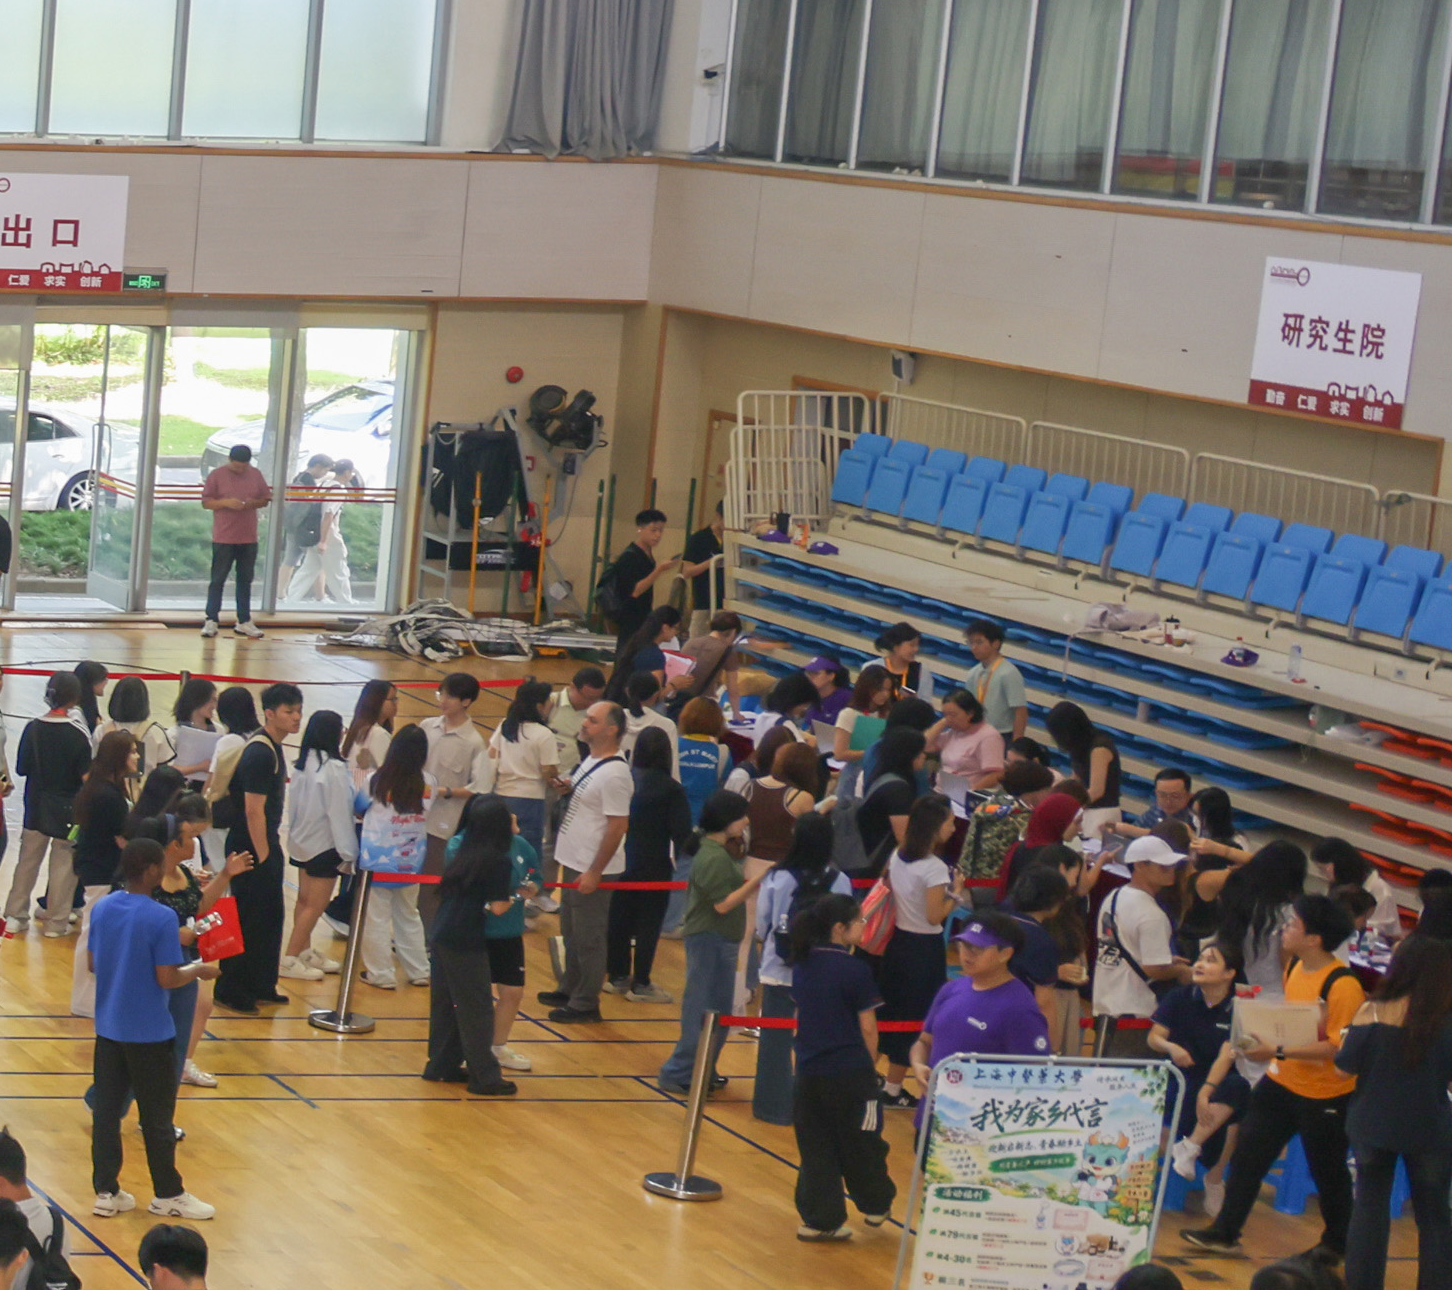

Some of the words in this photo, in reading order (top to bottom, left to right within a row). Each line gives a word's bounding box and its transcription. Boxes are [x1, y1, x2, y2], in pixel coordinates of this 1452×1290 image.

[1, 213, 80, 248] 出口
[8, 274, 30, 285] 仁爱
[44, 275, 66, 286] 求实
[80, 276, 102, 287] 创新
[1280, 312, 1386, 360] 研究生院
[970, 1097, 1109, 1133] 我为家乡代言
